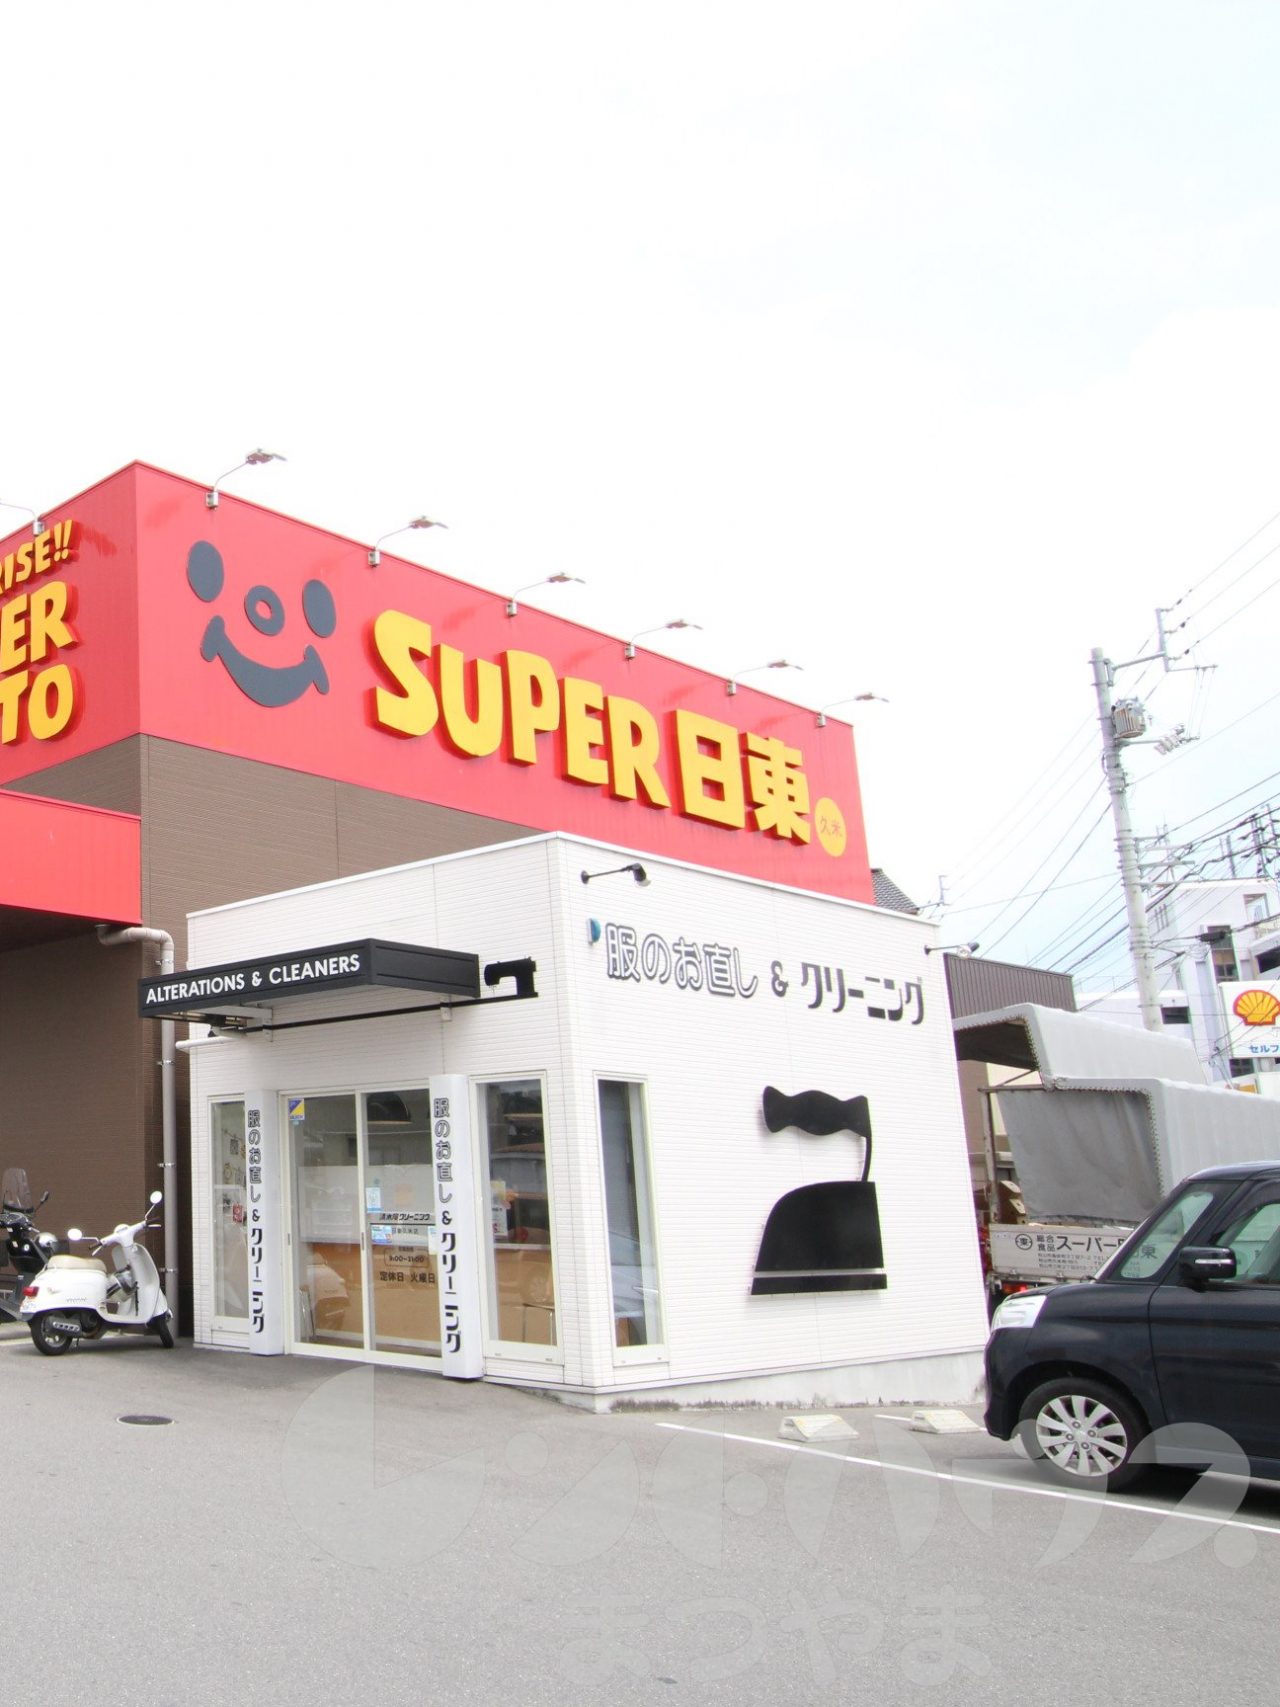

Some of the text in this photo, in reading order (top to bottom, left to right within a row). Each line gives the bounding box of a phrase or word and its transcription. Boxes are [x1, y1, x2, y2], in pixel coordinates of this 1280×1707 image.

[146, 953, 361, 1005] ALTERATIONS & CLEANERS
